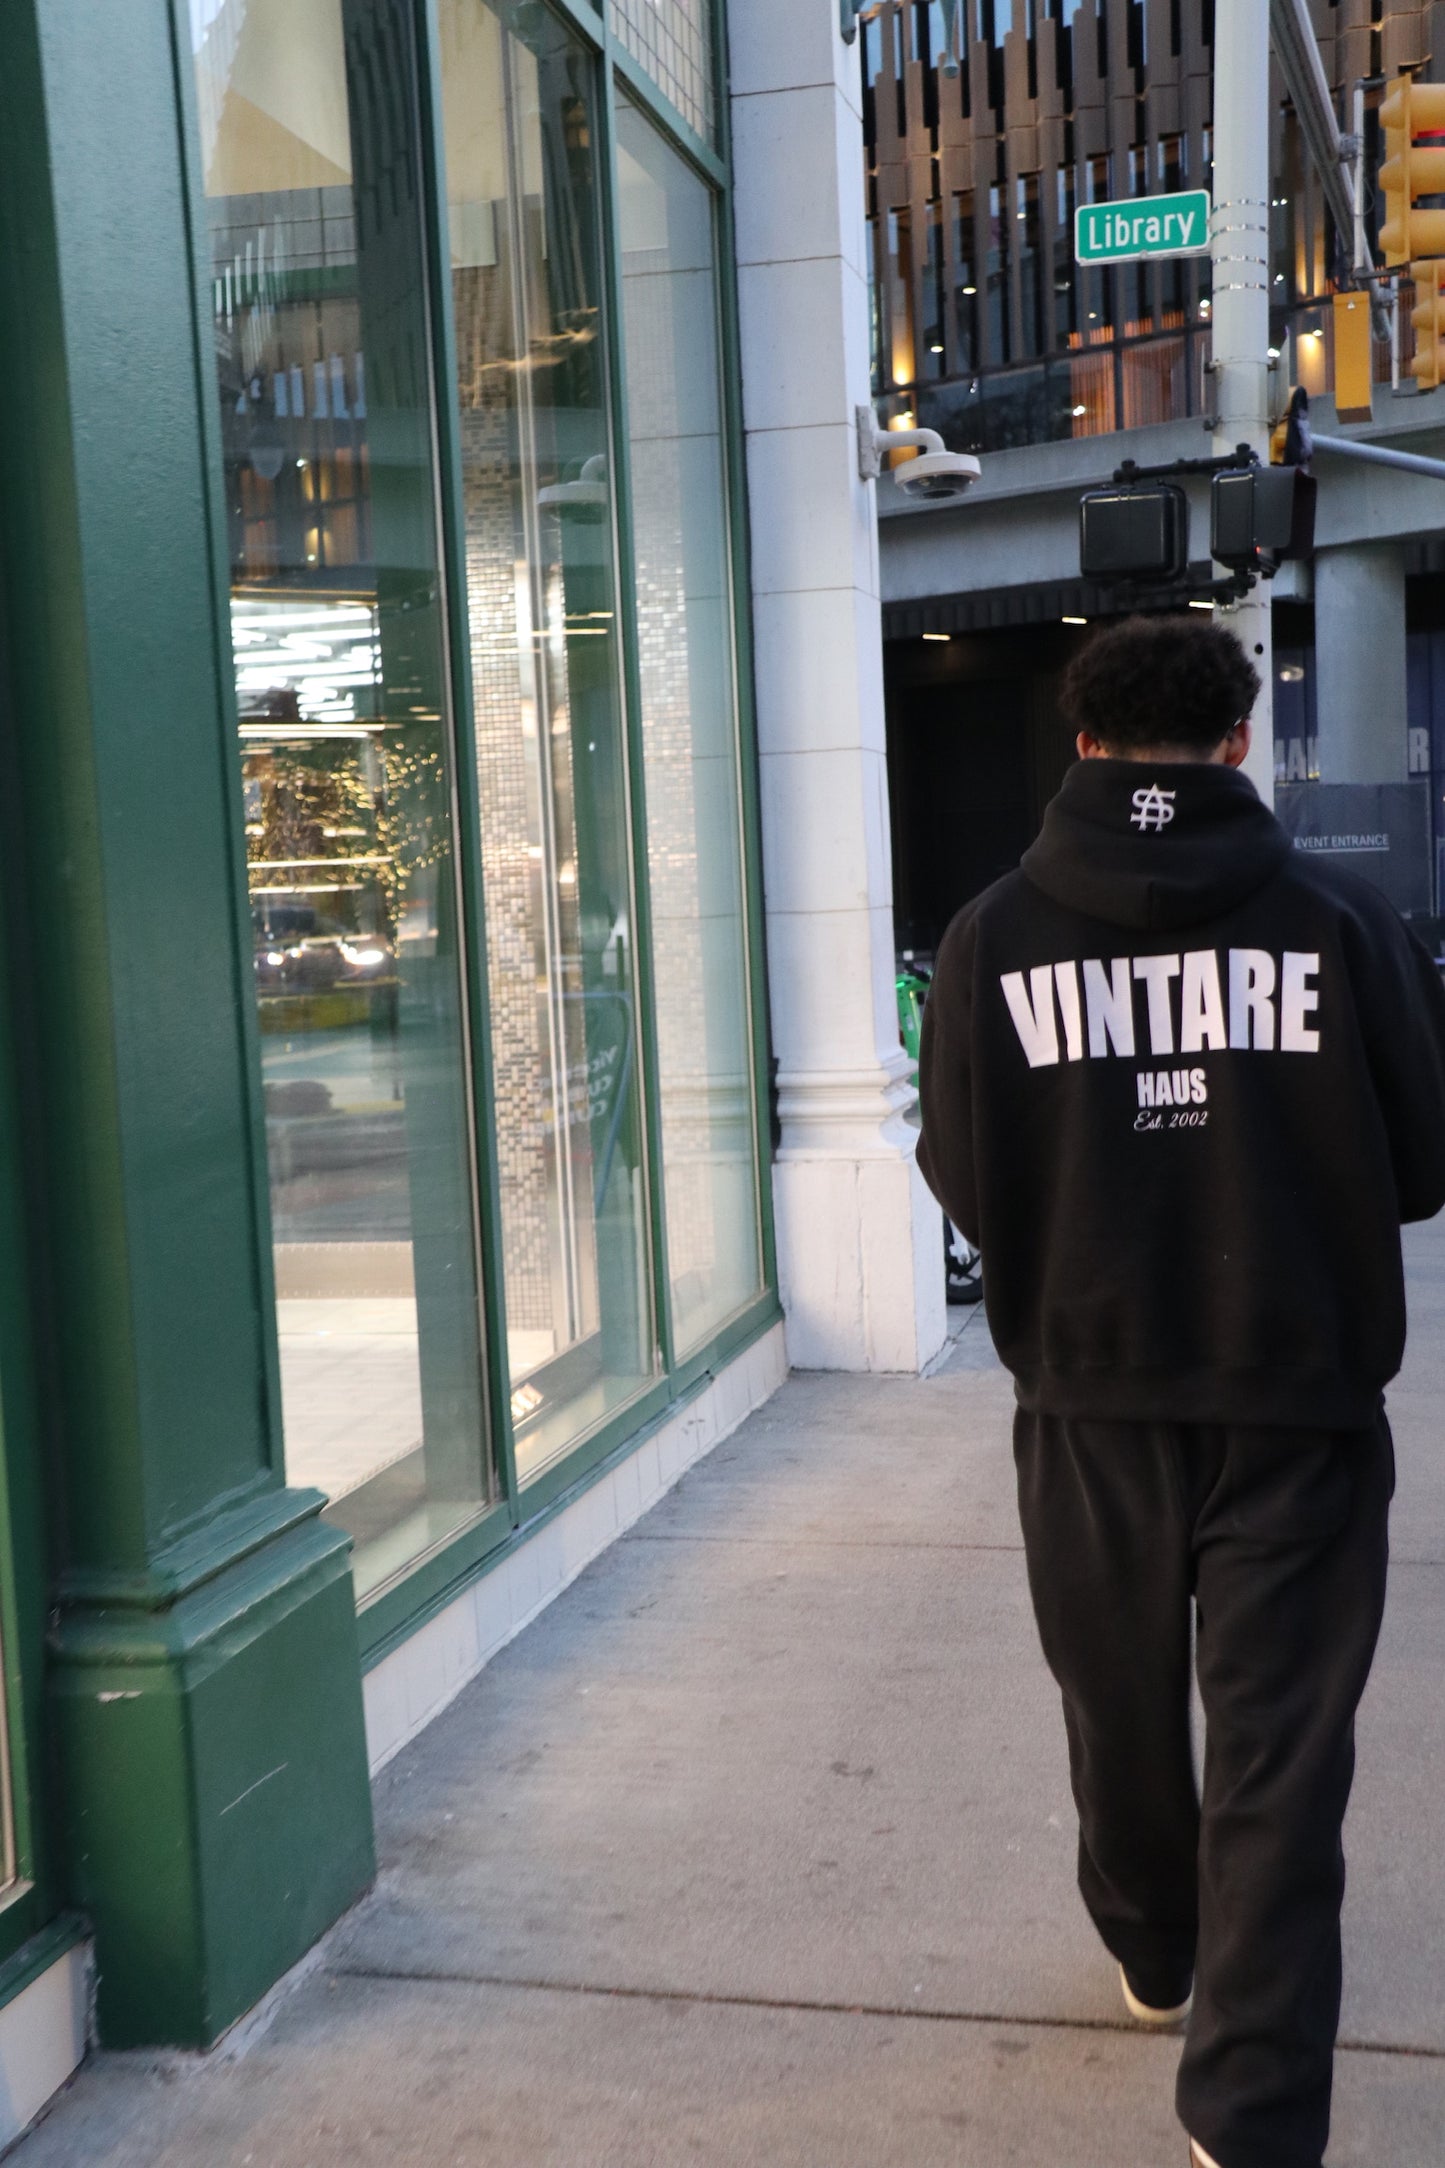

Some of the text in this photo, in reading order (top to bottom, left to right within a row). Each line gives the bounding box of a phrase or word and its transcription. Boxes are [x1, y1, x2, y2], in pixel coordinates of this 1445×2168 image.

[1089, 211, 1195, 250] Library
[1294, 833, 1389, 849] EVENT ENTRANCE
[1000, 948, 1319, 1068] VINTARE
[1136, 1067, 1207, 1108] HAUS
[1134, 1110, 1208, 1131] Est. 2002
